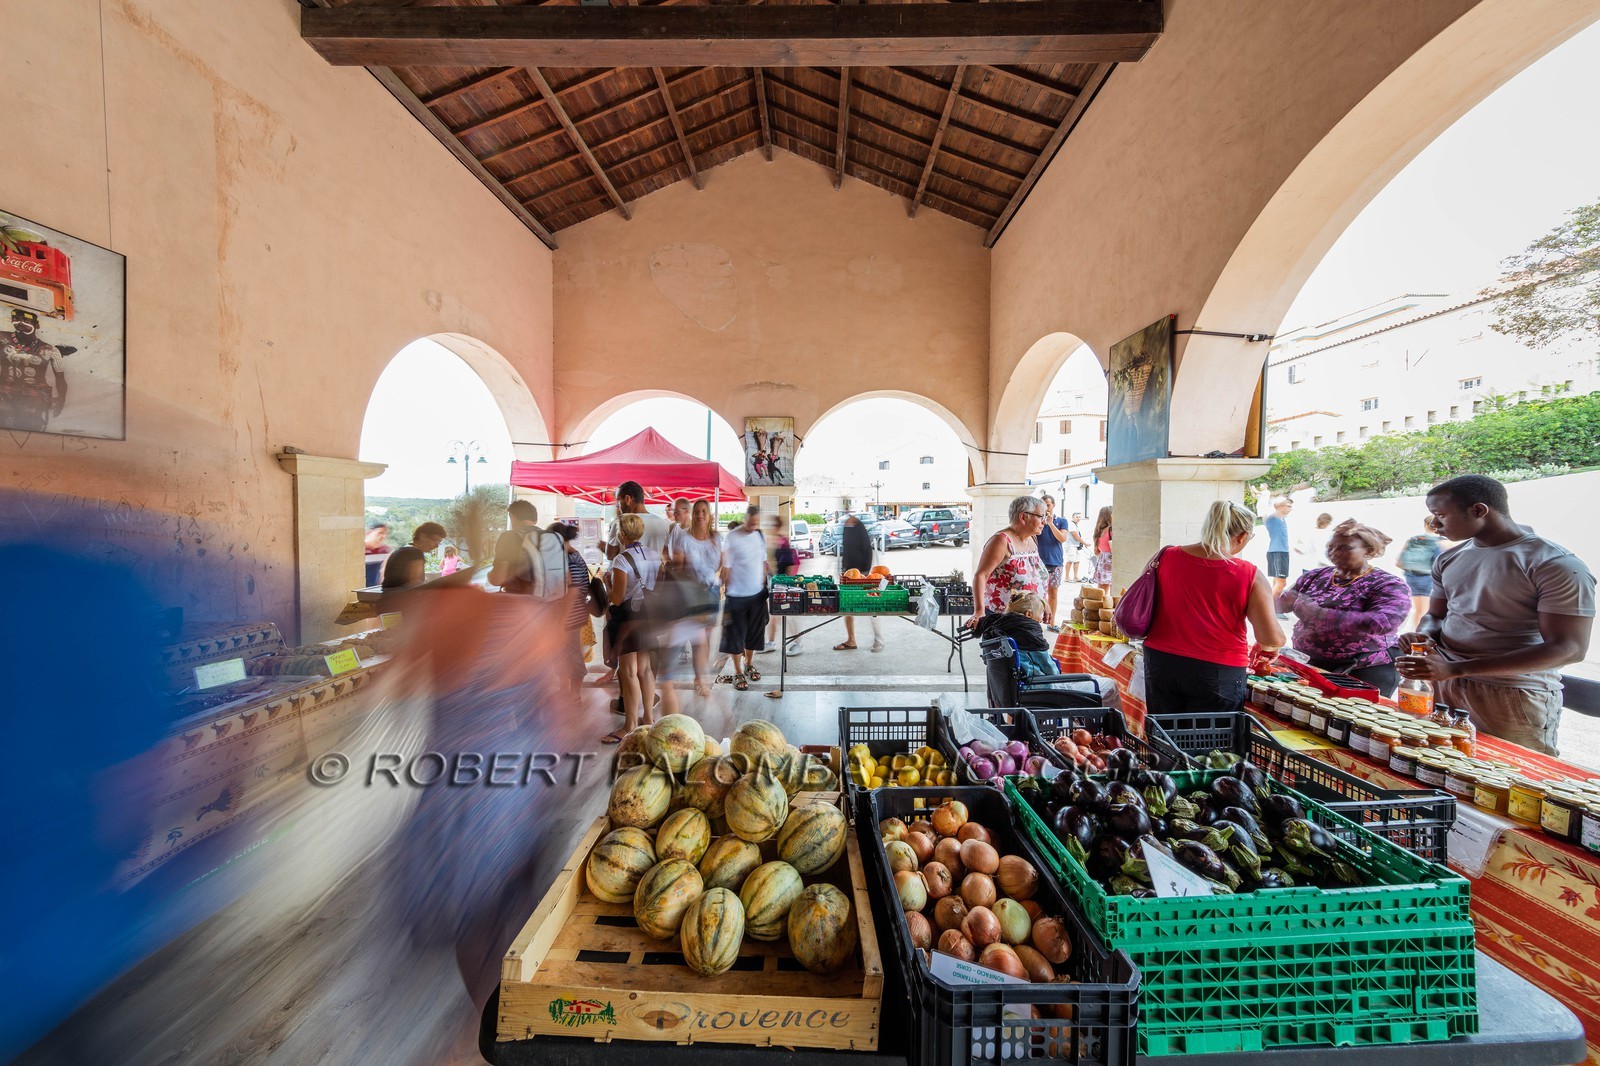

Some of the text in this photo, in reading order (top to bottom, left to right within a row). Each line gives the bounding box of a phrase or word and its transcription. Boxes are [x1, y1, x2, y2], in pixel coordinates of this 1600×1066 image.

[956, 963, 972, 972] CORSE
[977, 969, 1005, 982] BONIFACIO
[656, 1000, 851, 1031] Provence
